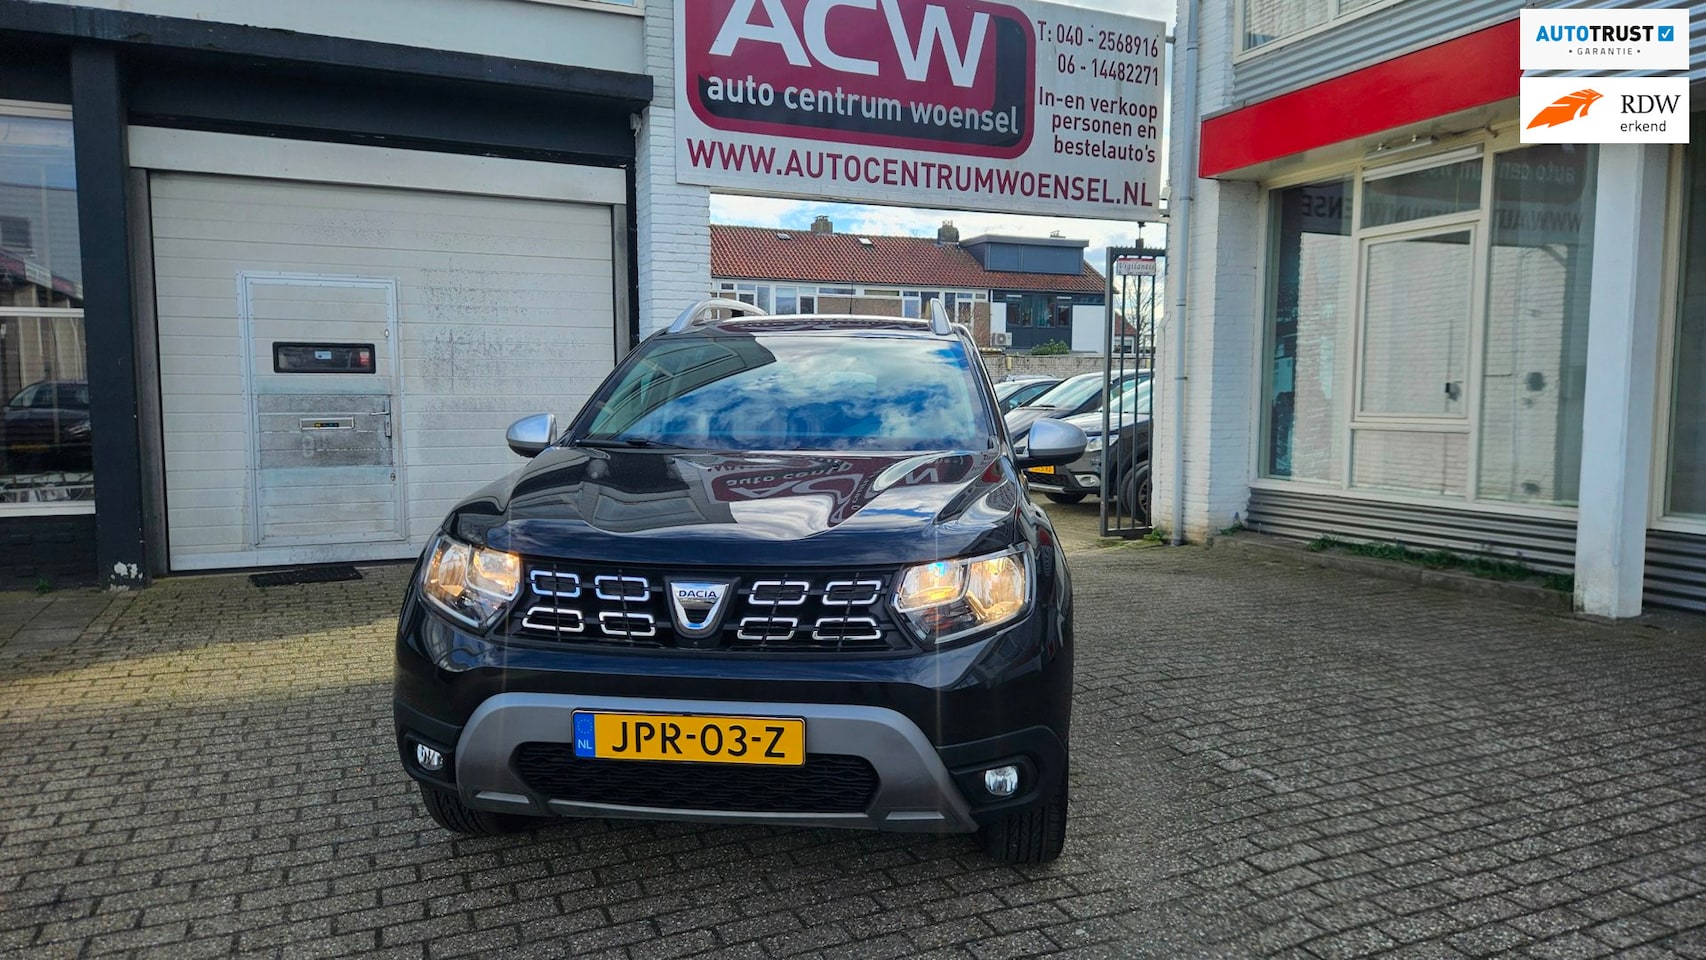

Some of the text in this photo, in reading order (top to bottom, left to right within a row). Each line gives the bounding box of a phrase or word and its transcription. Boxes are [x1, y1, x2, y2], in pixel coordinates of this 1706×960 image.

[708, 0, 990, 88] ACW
[1057, 23, 1083, 46] 040
[1098, 29, 1158, 58] 2568916
[1058, 53, 1075, 74] 06
[1091, 57, 1159, 86] 14482271
[707, 75, 1019, 135] auto centrum woensel
[1039, 86, 1158, 123] In-en verkoop
[1052, 113, 1157, 140] personen en
[1054, 134, 1156, 163] bestelauto's
[686, 138, 1153, 207] WWW.AUTOCENTRUMWOENSEL.NL
[678, 590, 717, 598] DACIA
[577, 721, 786, 759] NL JPR-03-Z
